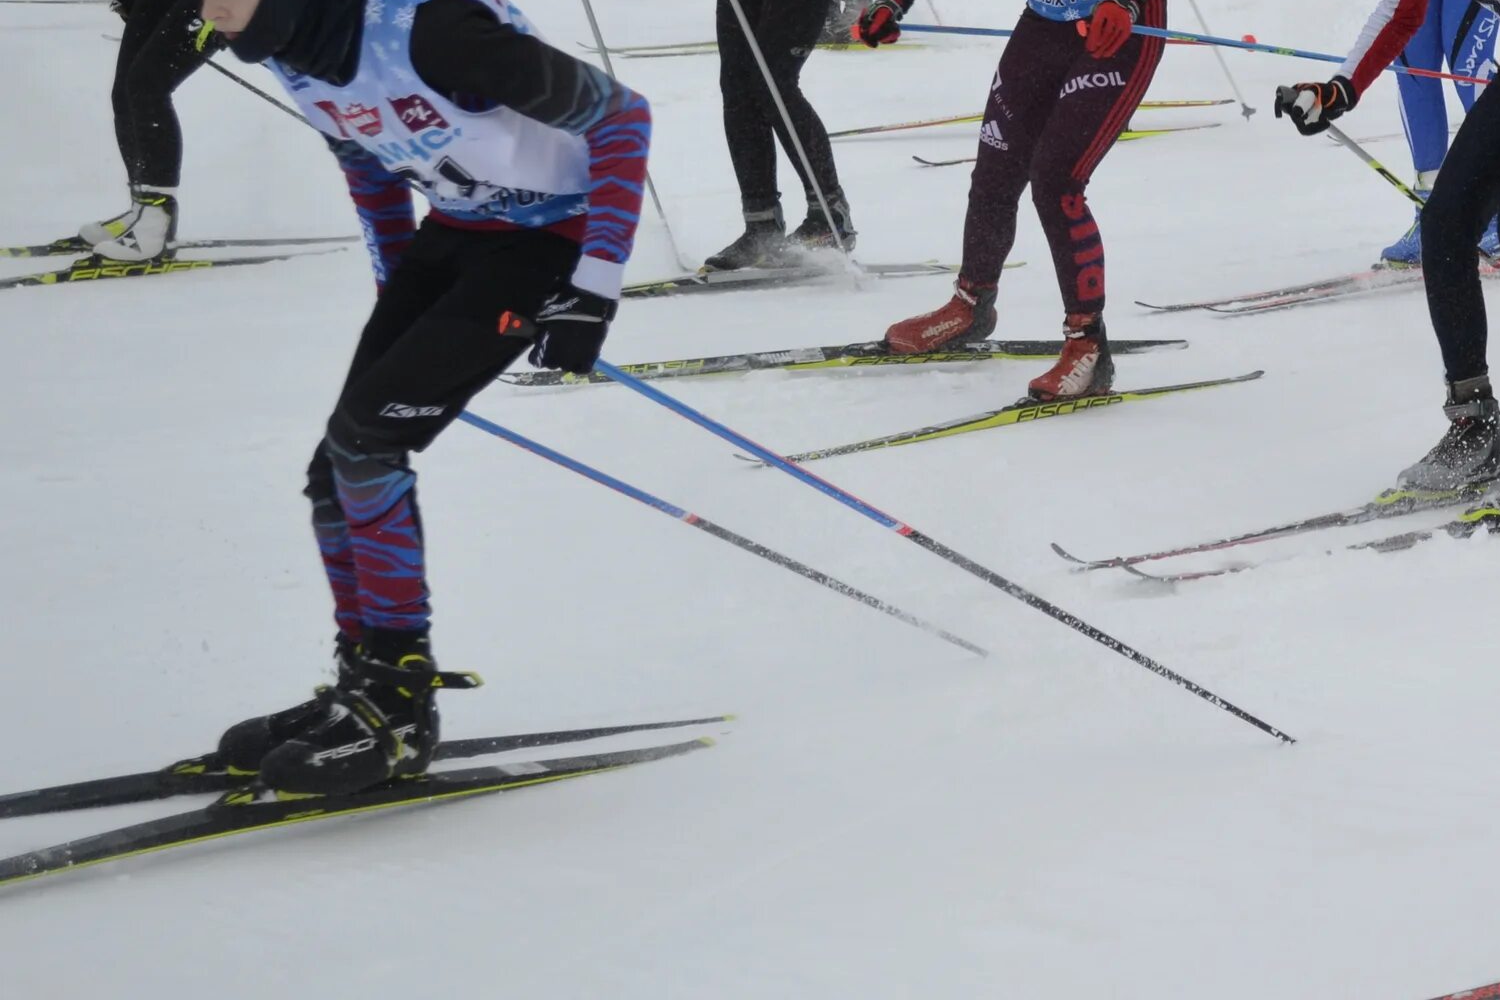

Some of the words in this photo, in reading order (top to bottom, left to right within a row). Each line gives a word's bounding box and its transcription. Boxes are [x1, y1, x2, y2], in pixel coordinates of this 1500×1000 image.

[69, 261, 213, 282] FISCHER
[921, 317, 963, 338] alpina
[850, 354, 993, 367] FISCHER
[1017, 396, 1123, 423] FISCHER
